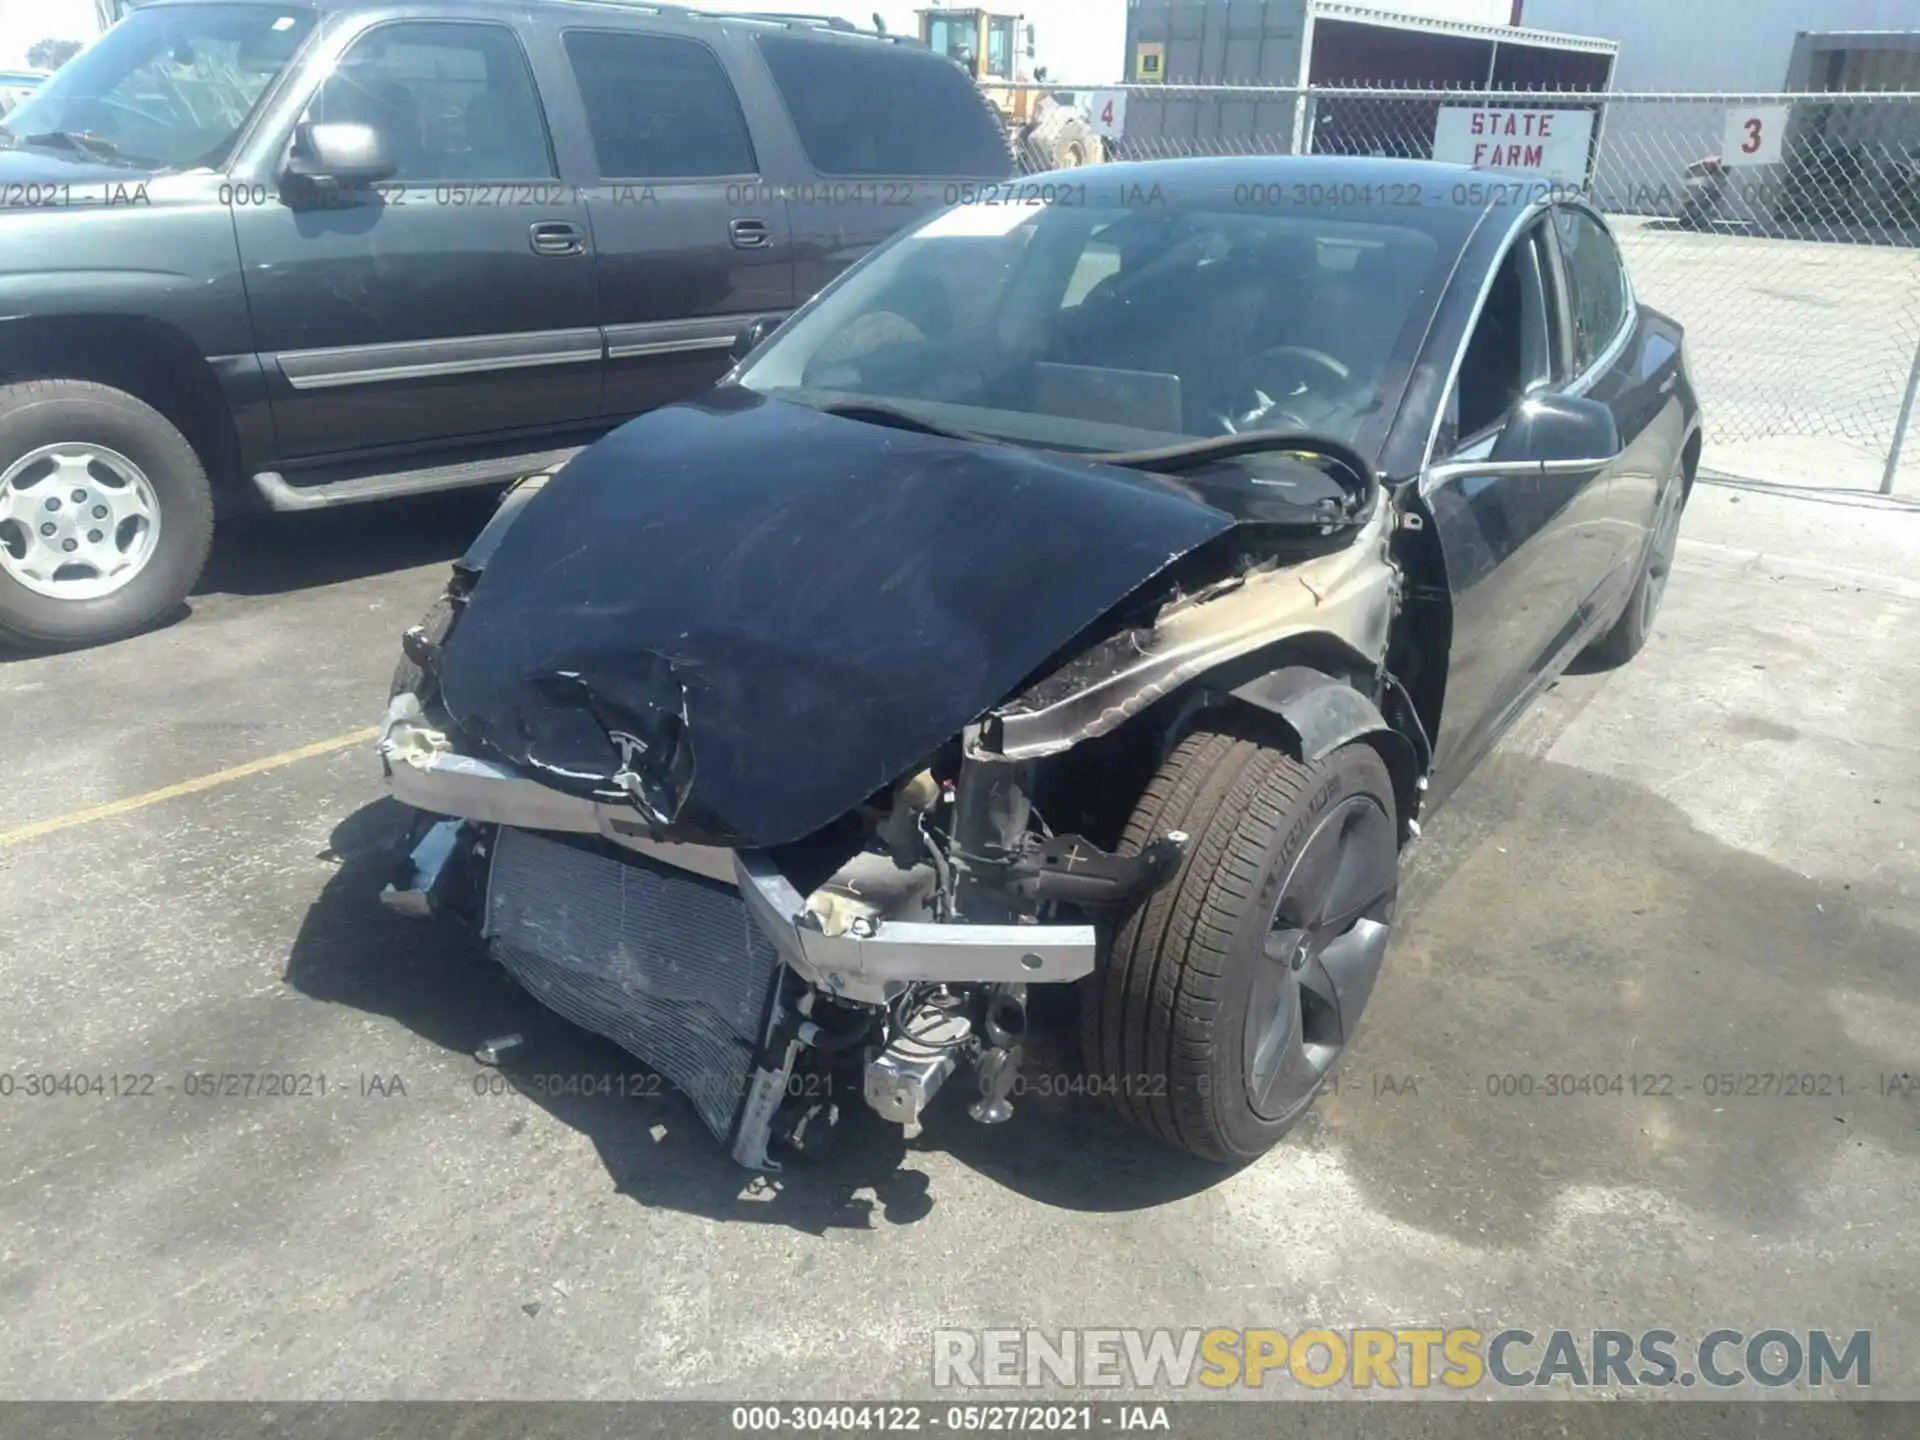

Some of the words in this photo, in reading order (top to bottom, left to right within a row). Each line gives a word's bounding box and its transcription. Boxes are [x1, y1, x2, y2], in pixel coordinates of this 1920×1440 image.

[1101, 99, 1113, 127] 4
[1470, 112, 1553, 137] STATE
[1741, 118, 1762, 154] 3
[1474, 143, 1543, 167] FARM
